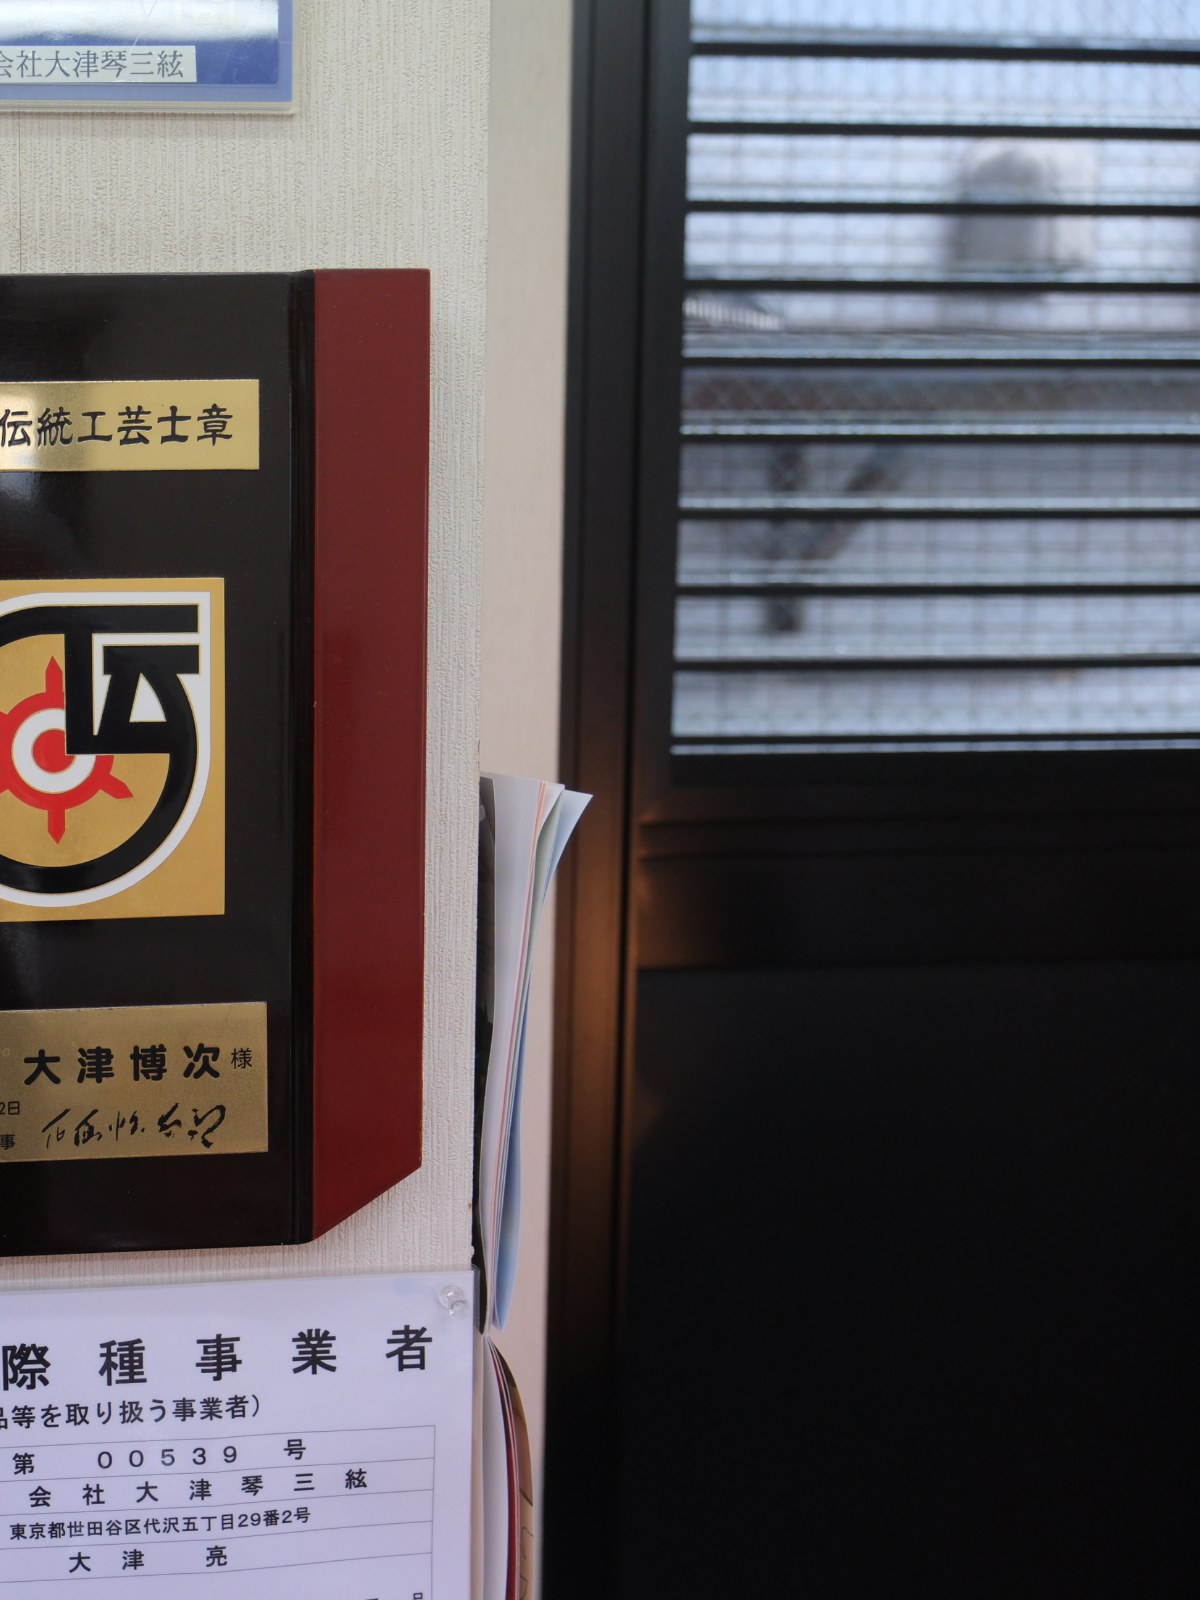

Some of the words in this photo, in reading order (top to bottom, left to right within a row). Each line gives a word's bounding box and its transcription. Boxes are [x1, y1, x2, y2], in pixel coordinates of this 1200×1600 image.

[9, 1506, 311, 1541] 東京都世田谷区代沢五丁目29番2号
